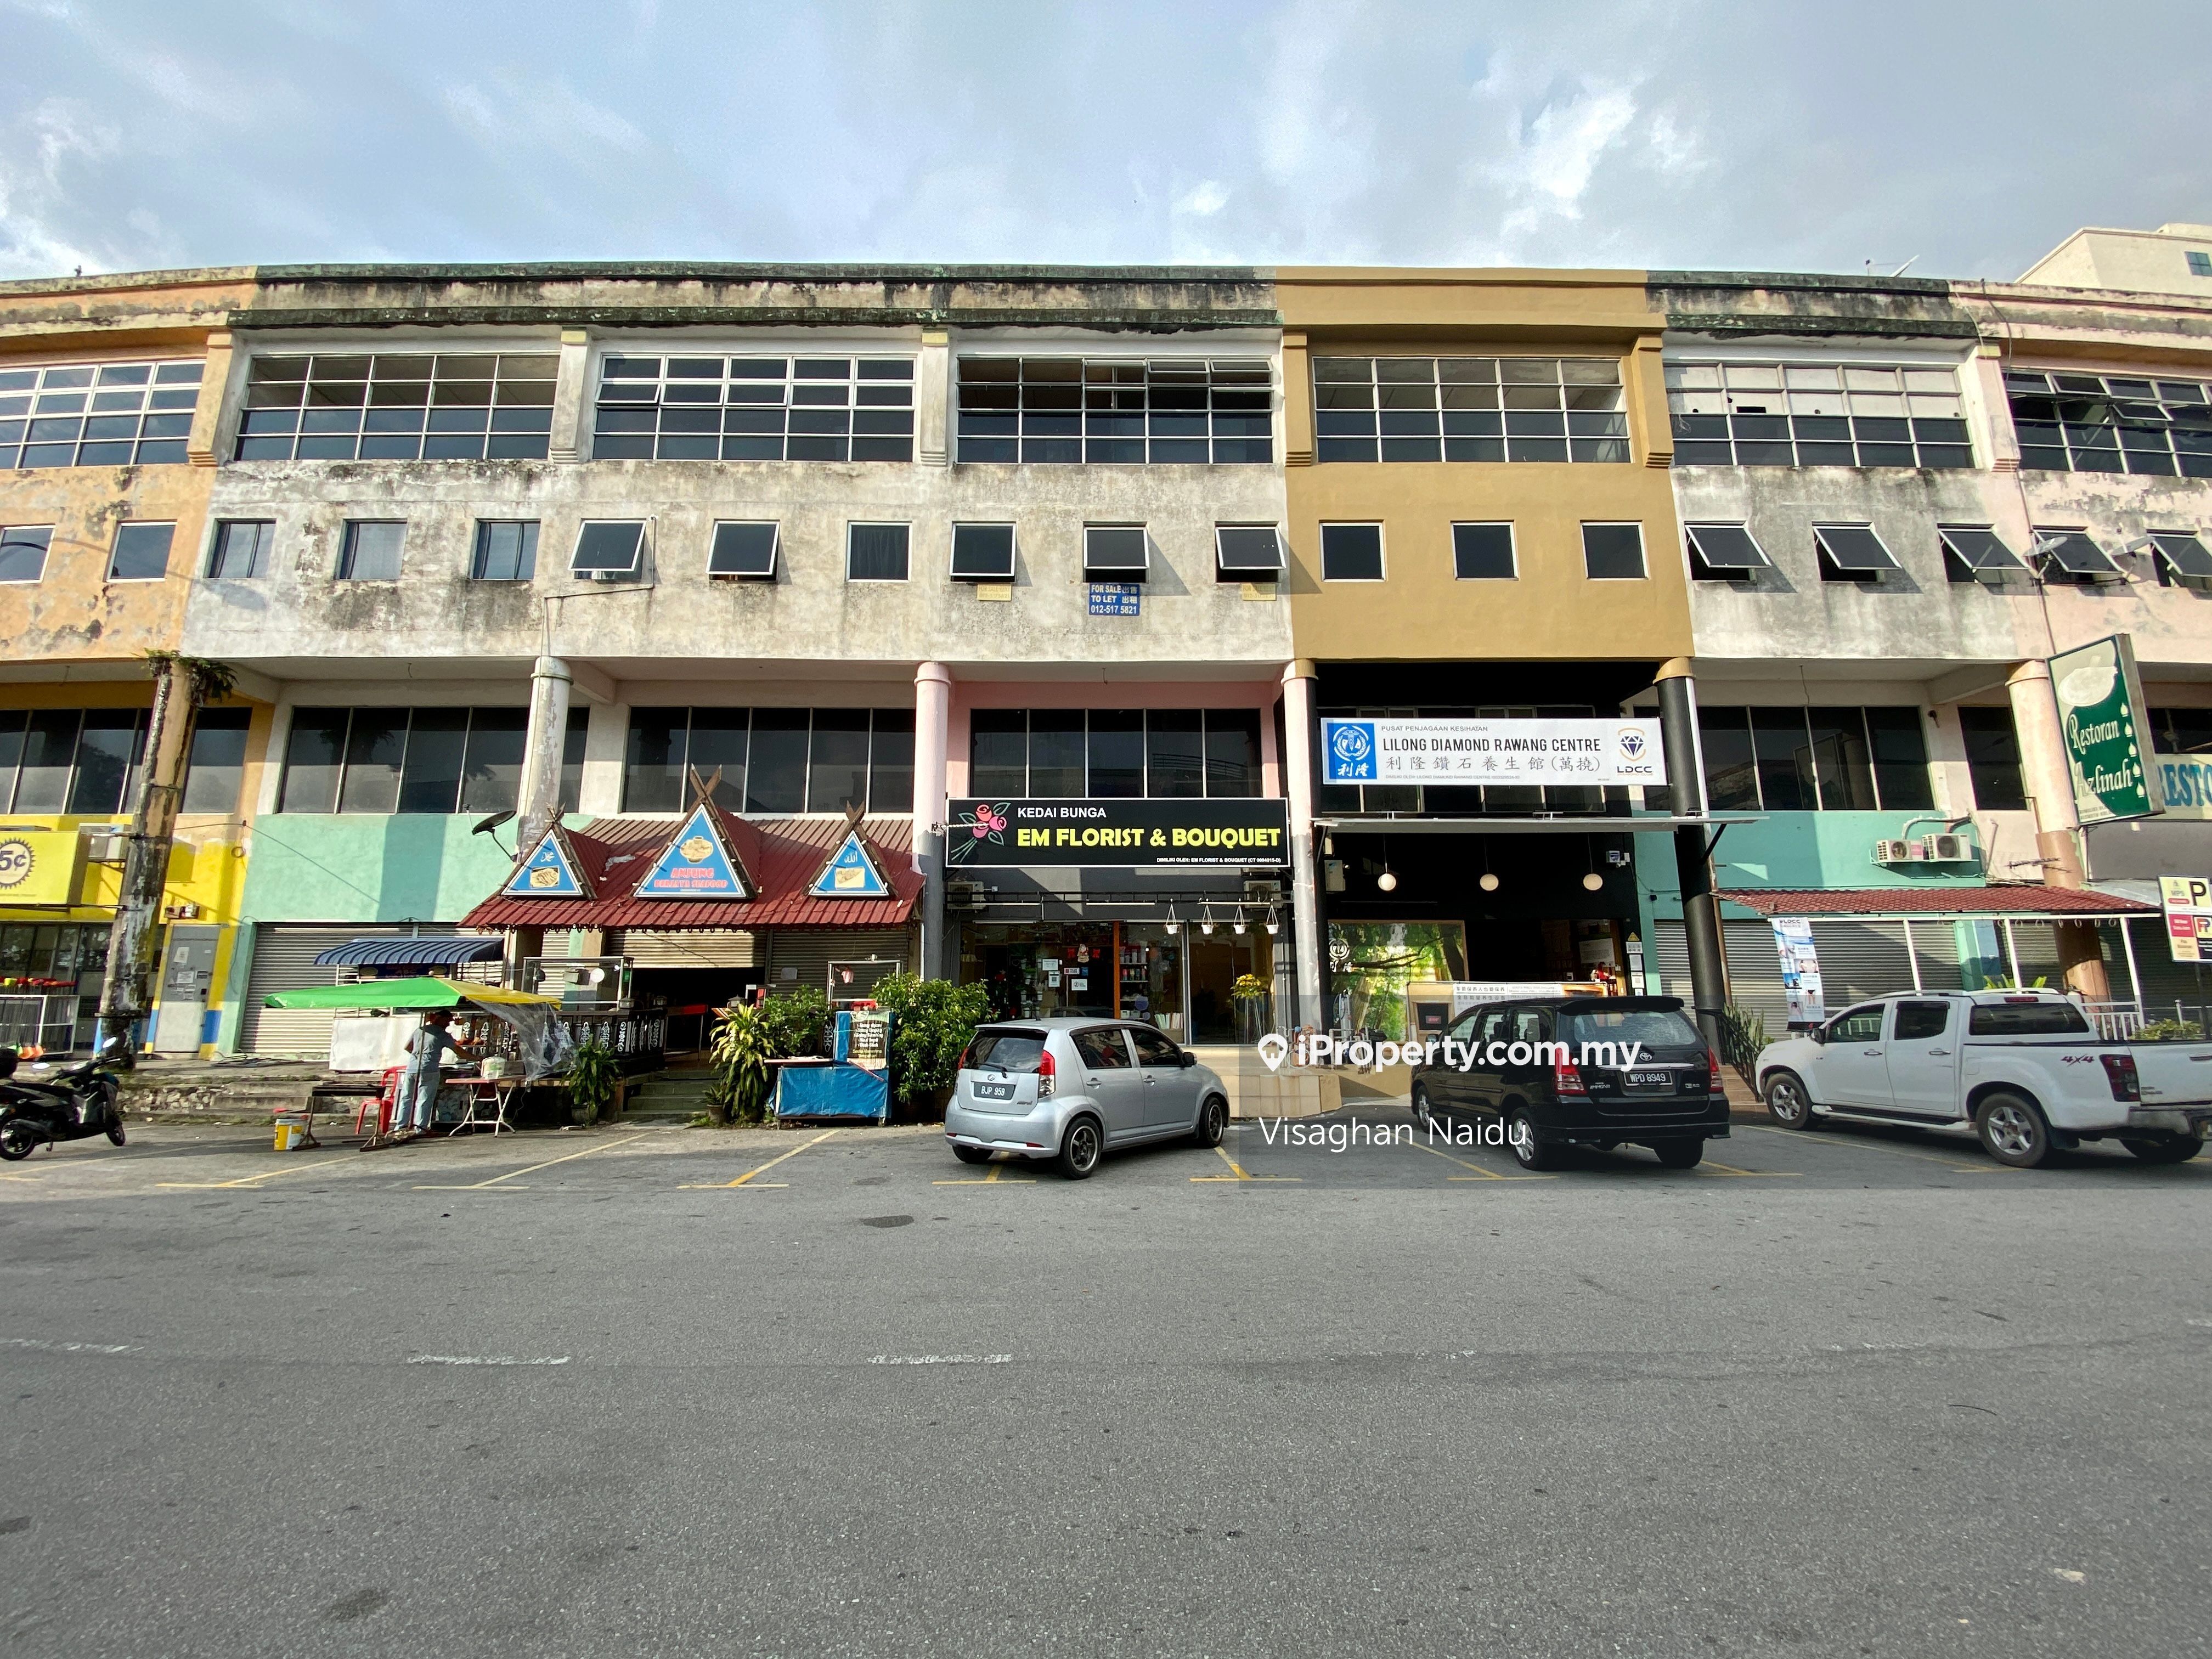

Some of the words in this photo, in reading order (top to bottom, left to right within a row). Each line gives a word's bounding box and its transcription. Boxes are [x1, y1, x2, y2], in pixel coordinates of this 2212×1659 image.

[1105, 585, 1121, 593] SALE
[1091, 605, 1119, 613] 012-517
[1120, 606, 1137, 614] 5821
[2069, 714, 2120, 755] Restoran
[1383, 738, 1426, 751] LILONG
[1432, 738, 1489, 752] DIAMOND
[1495, 738, 1547, 752] RAWANG
[1552, 738, 1601, 752] CENTRE
[2075, 758, 2133, 797] Azlinah
[1018, 807, 1057, 818] KEDAI
[1060, 807, 1107, 818] BUNGA
[1018, 828, 1049, 847] EM
[1056, 828, 1144, 847] FLORIST
[1149, 828, 1166, 847] &
[1172, 828, 1280, 849] BOUQUET
[670, 867, 714, 878] ANJUNG
[2189, 881, 2207, 906] P
[1630, 1074, 1645, 1082] WPD
[1646, 1073, 1666, 1082] 8949
[981, 1086, 992, 1094] BJP
[994, 1087, 1005, 1096] 959
